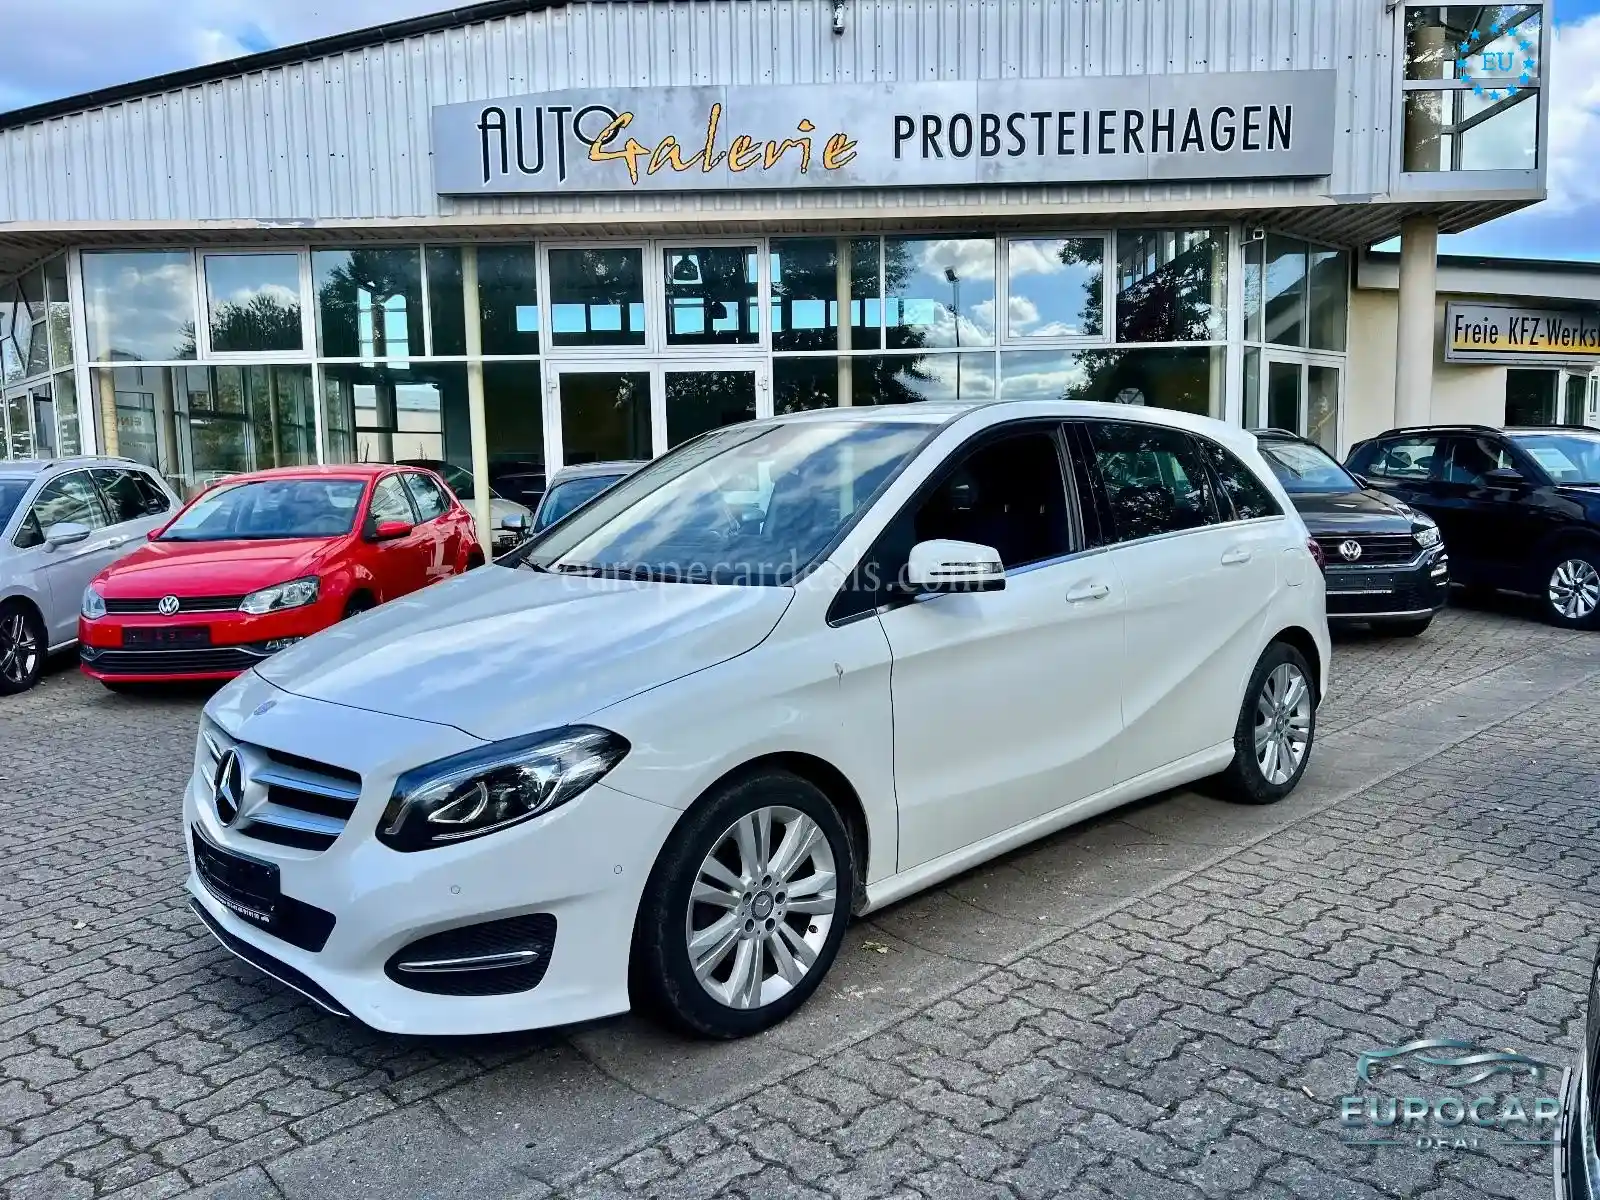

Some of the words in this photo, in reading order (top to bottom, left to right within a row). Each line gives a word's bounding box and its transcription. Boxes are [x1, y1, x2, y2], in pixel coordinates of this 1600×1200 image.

[476, 105, 622, 184] AUTO
[588, 103, 857, 185] Galerie
[893, 105, 1292, 160] PROBSTEIERHAGEN
[1454, 314, 1499, 344] Freie
